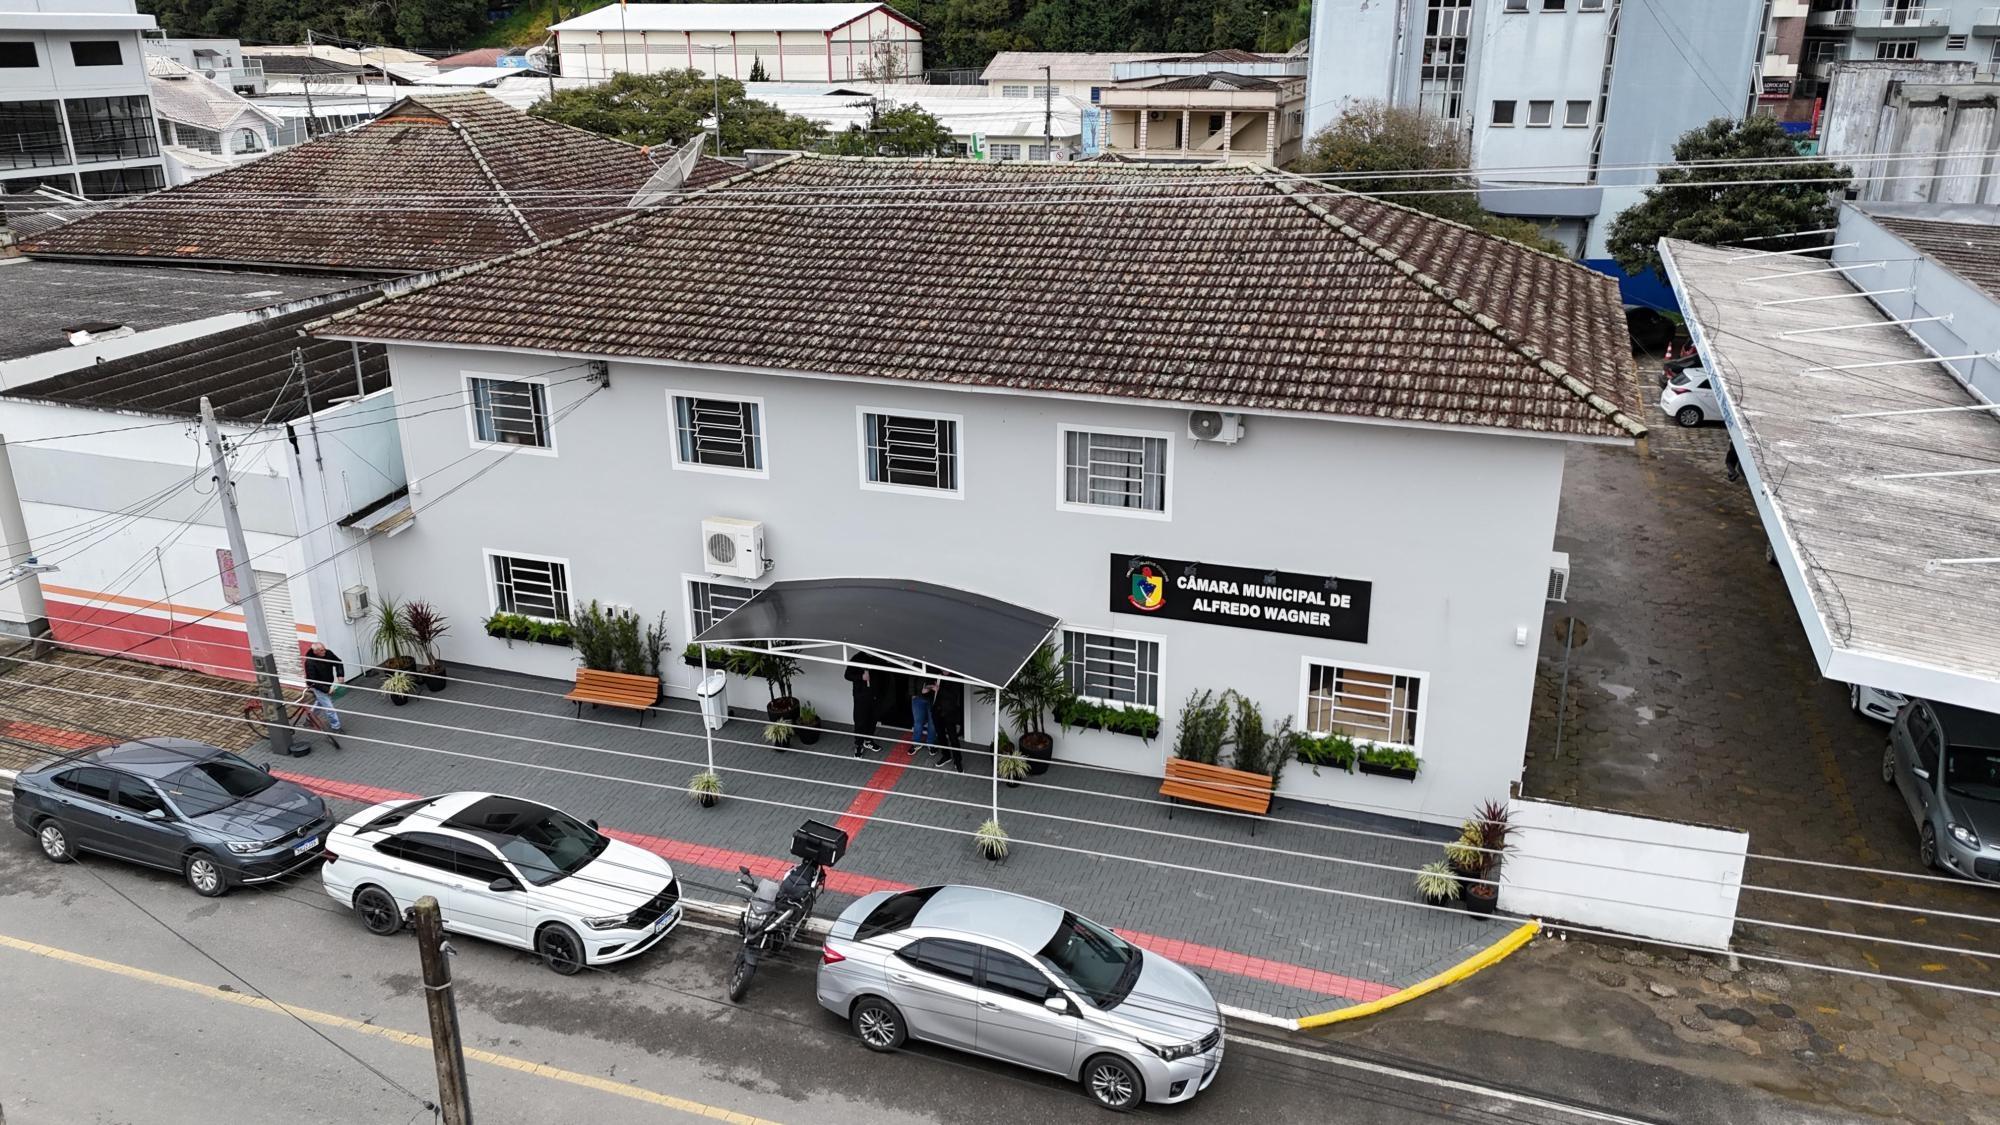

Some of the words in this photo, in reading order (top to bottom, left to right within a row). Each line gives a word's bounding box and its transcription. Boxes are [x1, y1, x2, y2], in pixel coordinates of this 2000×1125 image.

[1176, 575, 1240, 596] CÂMARA
[1242, 583, 1326, 606] MUNICIPAL
[1329, 593, 1351, 609] DE
[1192, 598, 1261, 618] ALFREDO
[1263, 606, 1331, 627] WAGNER
